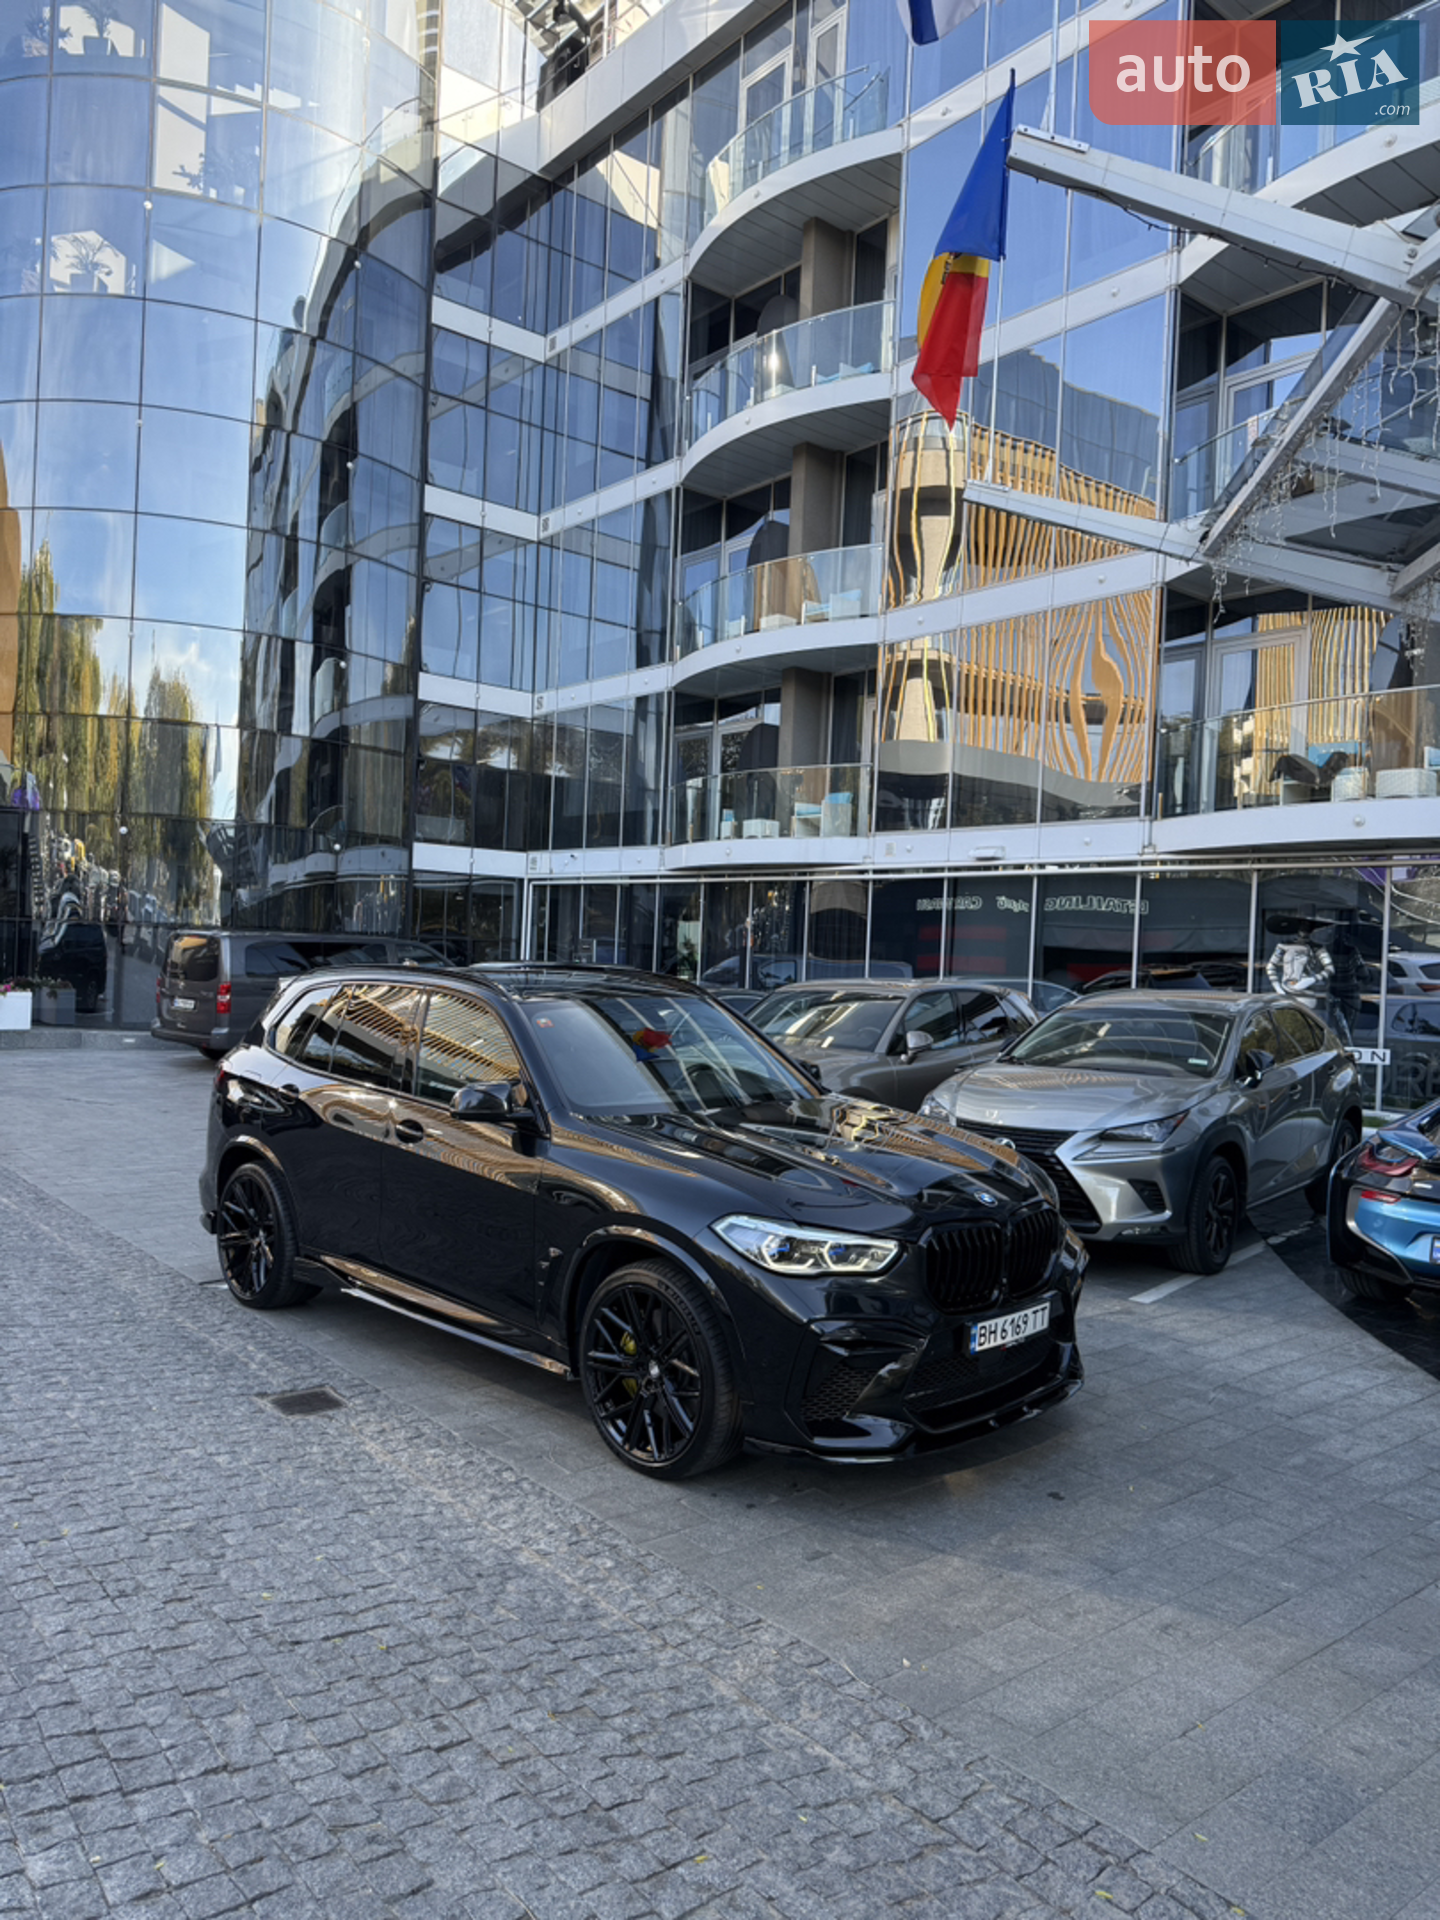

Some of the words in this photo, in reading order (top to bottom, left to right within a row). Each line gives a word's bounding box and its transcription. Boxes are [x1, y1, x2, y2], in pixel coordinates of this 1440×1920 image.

[978, 1322, 998, 1347] BH
[1001, 1313, 1028, 1340] 6169
[1032, 1306, 1048, 1330] TT
